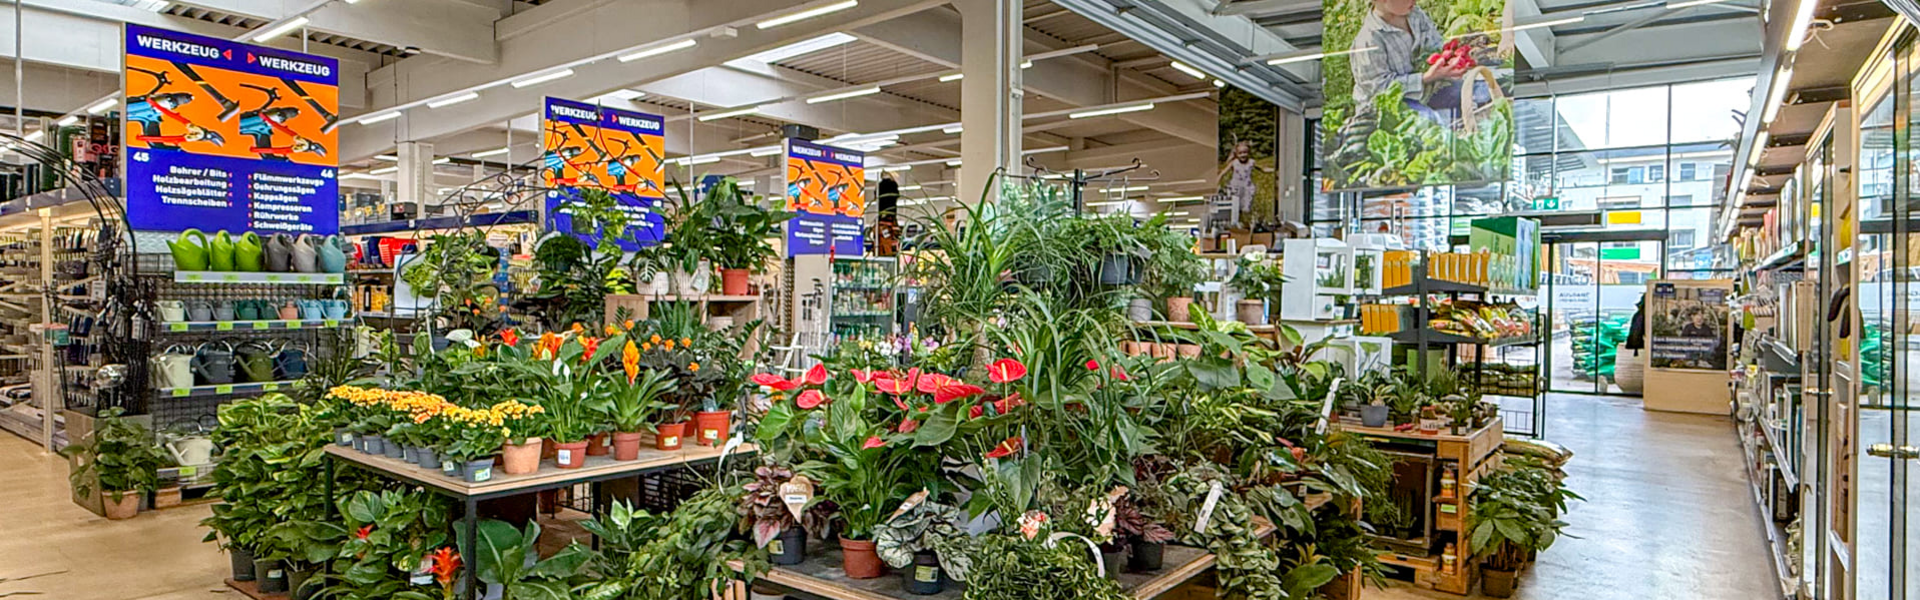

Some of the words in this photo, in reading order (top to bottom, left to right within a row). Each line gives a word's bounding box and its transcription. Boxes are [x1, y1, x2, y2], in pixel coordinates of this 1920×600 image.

[136, 34, 220, 59] WERKZEUG
[259, 55, 331, 77] WERKZEUG
[133, 151, 150, 162] 45
[169, 165, 202, 177] Bohrer
[209, 169, 228, 179] Bits
[320, 169, 334, 179] 46
[152, 174, 227, 189] Holzbearbeitung
[253, 172, 325, 187] Flämmwerkzeuge
[155, 184, 227, 198] Holzsägeblätter
[253, 183, 316, 195] Gehrungssägen
[161, 195, 228, 208] Trennscheiben
[253, 192, 299, 203] Kappsägen
[253, 202, 313, 213] Kompressoren
[253, 211, 299, 222] Rührwerke
[253, 221, 314, 232] Schweißgeräte
